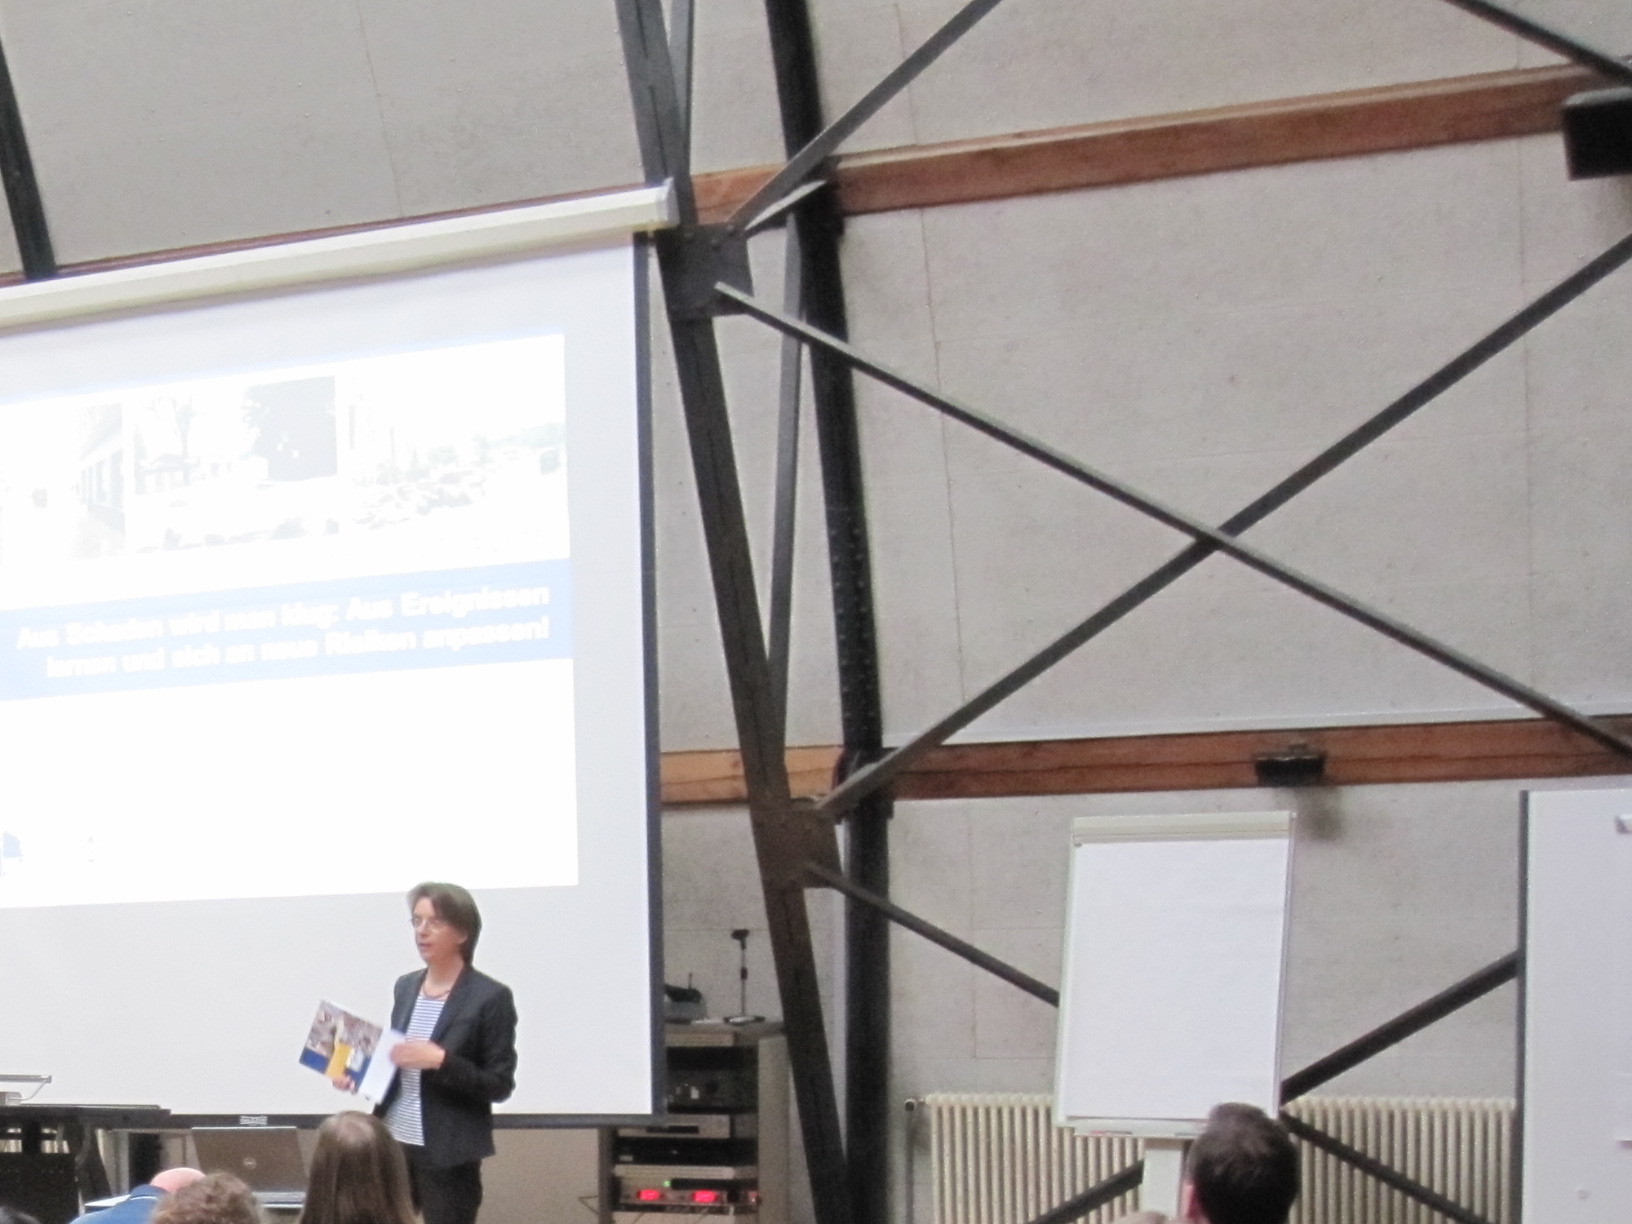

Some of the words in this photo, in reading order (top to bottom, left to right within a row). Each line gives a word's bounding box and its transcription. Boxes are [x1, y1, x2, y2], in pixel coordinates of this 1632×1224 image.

[16, 626, 60, 650] Aus
[168, 609, 221, 637] wird
[224, 610, 277, 632] man
[345, 597, 394, 621] Aus
[122, 646, 165, 673] und
[171, 642, 221, 669] sich
[225, 644, 256, 665] an
